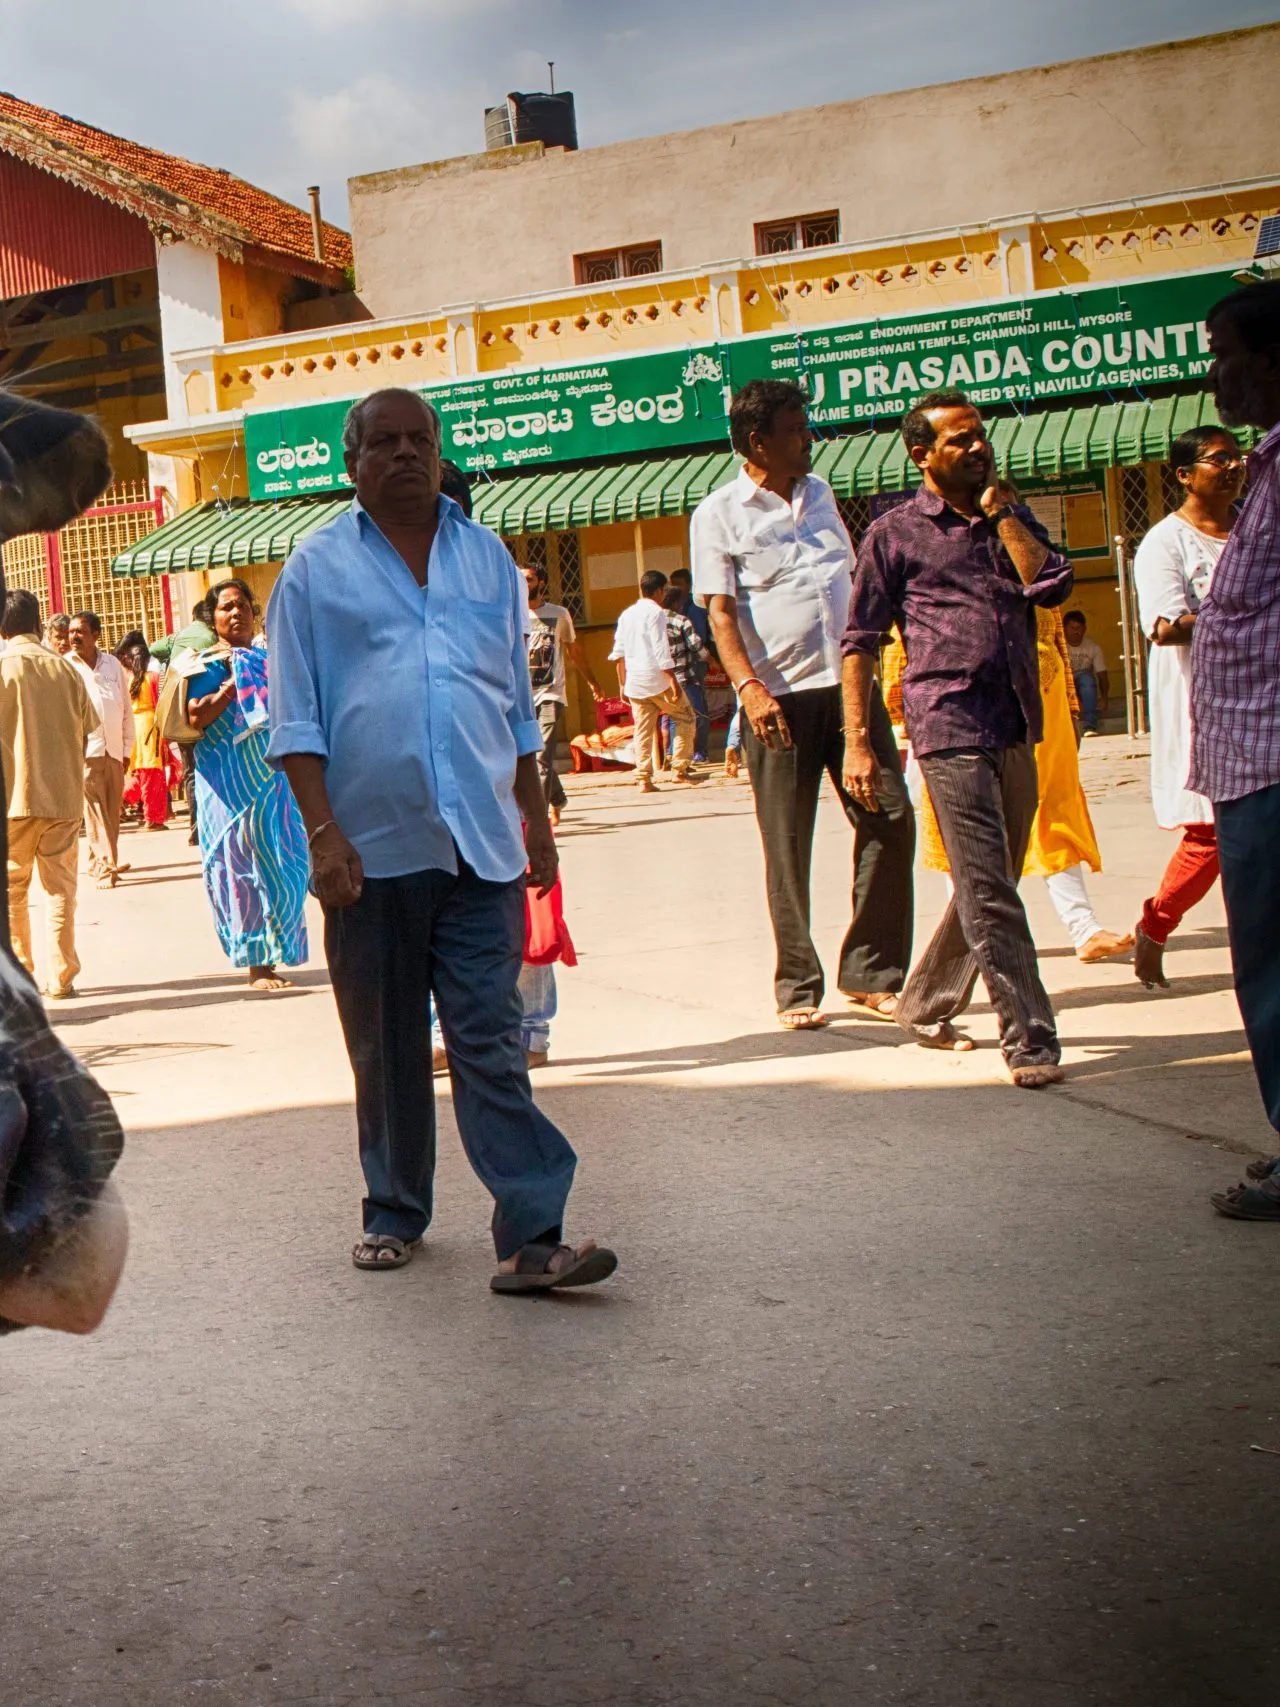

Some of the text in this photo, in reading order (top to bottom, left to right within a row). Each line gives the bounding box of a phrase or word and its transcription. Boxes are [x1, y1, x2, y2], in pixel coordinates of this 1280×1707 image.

[771, 311, 1132, 369] SHRI CHAMUNDESHWARI TEMPLE, CHAMUNDI HILL, MYSORE
[870, 320, 947, 339] ENDOWMENT
[951, 308, 1033, 329] DEPARTMENT
[493, 377, 524, 390] GOVT.
[526, 376, 541, 386] OF
[543, 367, 609, 384] KARNATAKA
[808, 405, 850, 422] NAME
[854, 399, 905, 417] BOARD
[1034, 373, 1092, 394] NAVILU
[1097, 364, 1184, 386] AGENCIES,
[839, 345, 1031, 400] PRASADA
[452, 385, 684, 447] ಮಾರಾಟ ಕೇಂದ್ರ
[257, 437, 330, 473] ಲಾಡು
